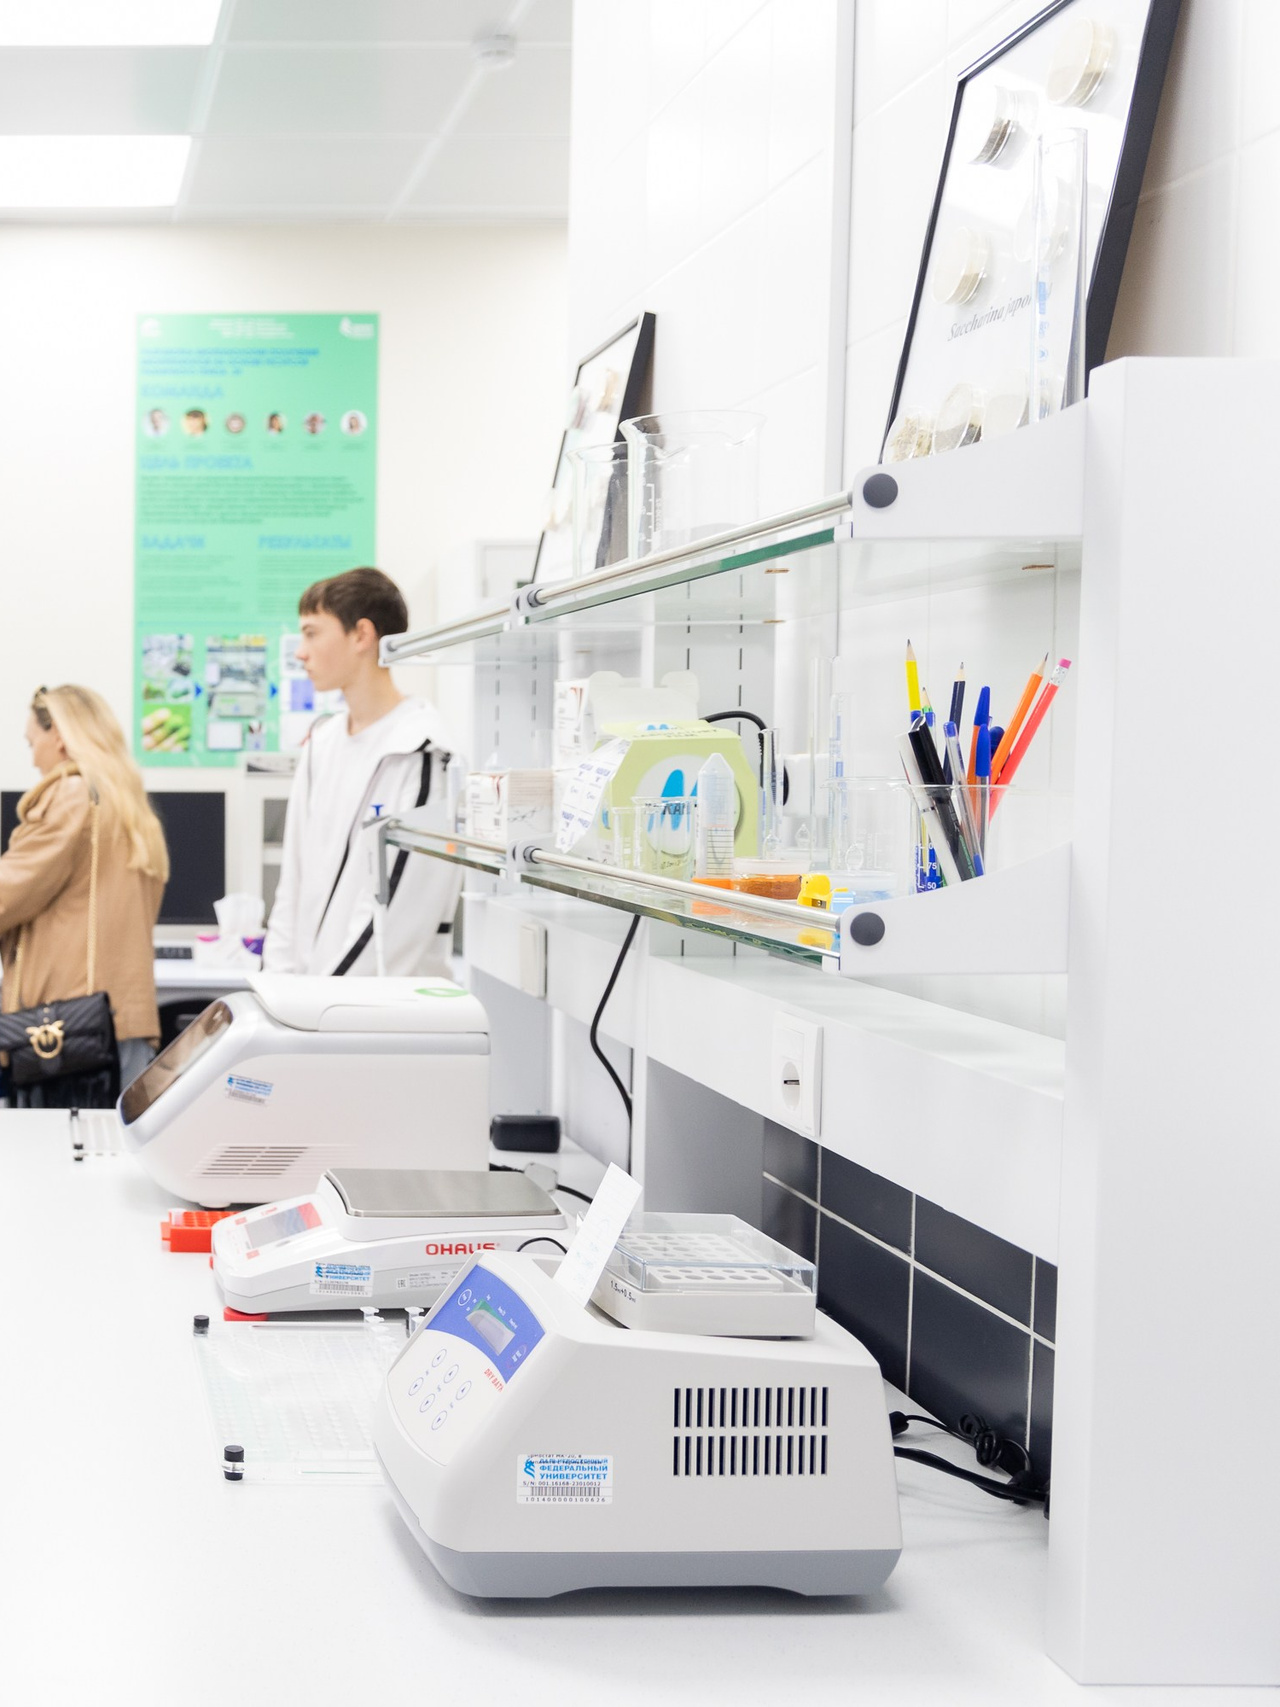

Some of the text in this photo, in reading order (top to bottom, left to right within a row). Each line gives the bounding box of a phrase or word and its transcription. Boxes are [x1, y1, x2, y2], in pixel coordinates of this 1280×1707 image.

[947, 306, 1005, 341] Saccharina
[927, 881, 937, 890] 50
[425, 1243, 495, 1255] OHAUS
[484, 1368, 504, 1393] DRY BATH
